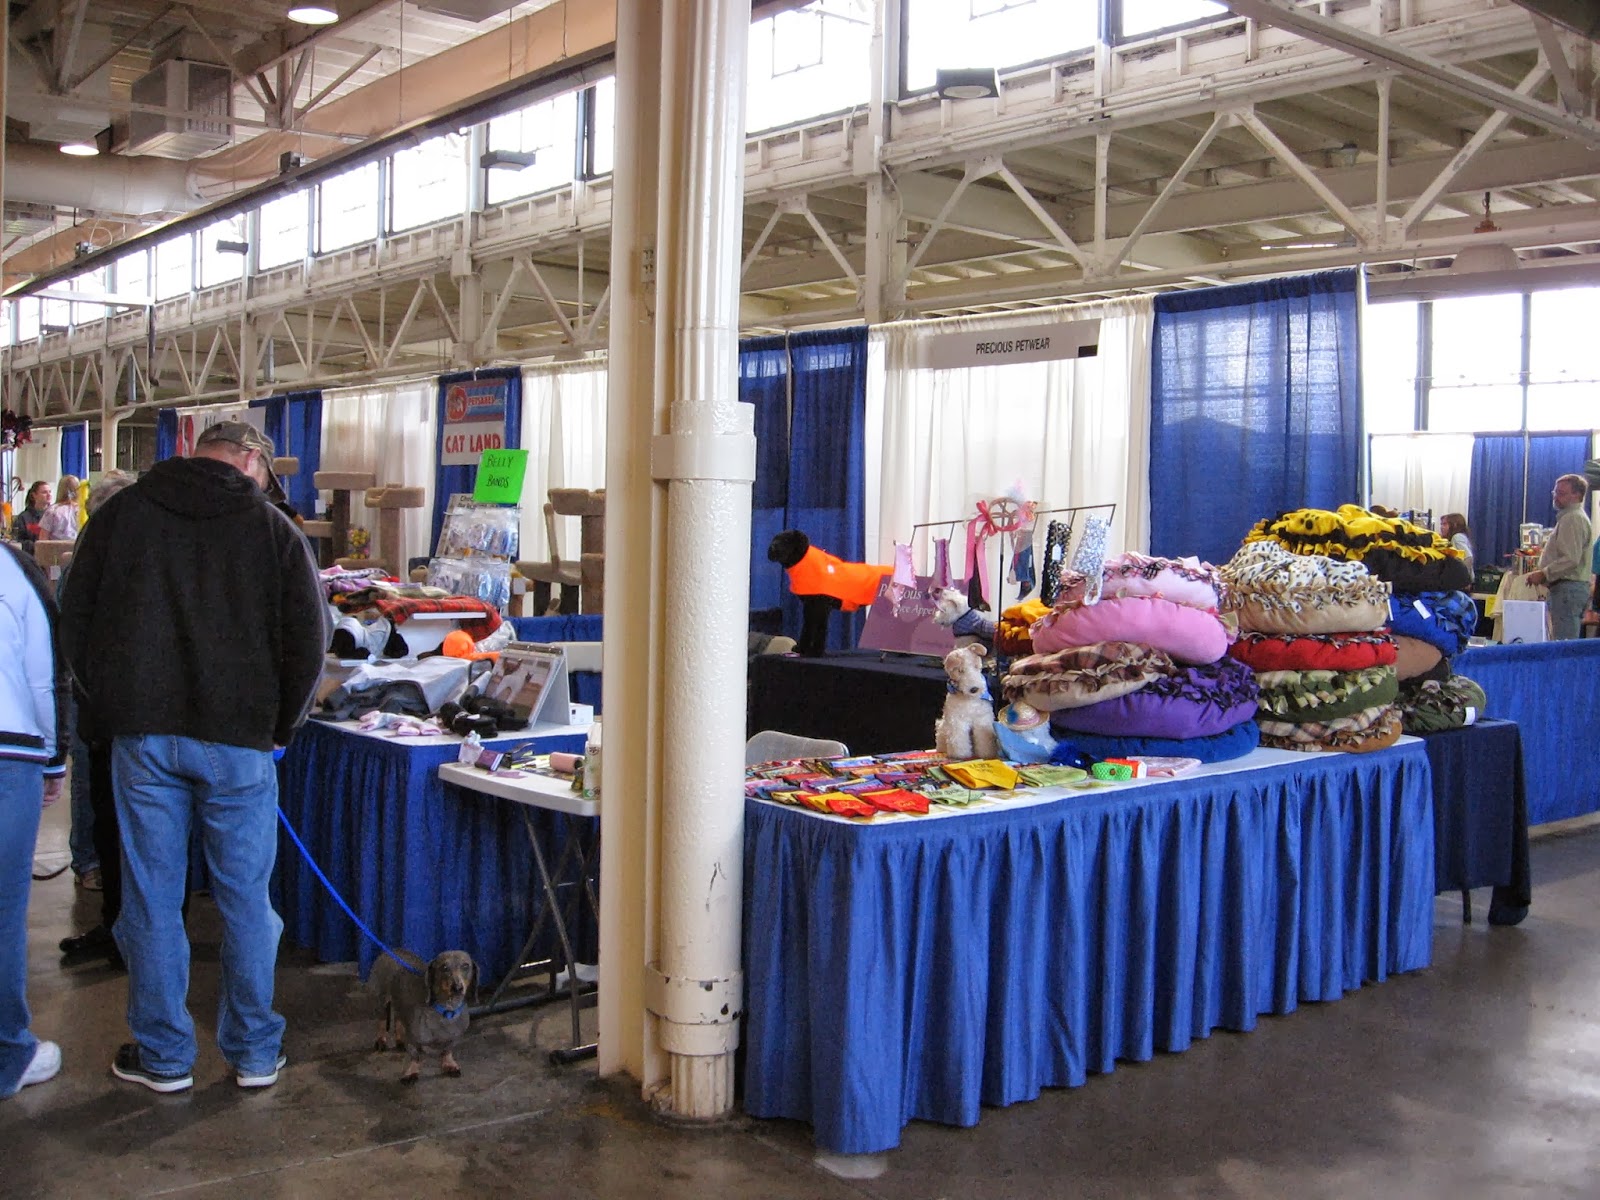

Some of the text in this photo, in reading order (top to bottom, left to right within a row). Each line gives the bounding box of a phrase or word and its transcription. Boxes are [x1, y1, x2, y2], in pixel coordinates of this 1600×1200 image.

[976, 337, 1050, 355] PRECIOUS PETWEAR
[445, 433, 501, 453] CAT LAND
